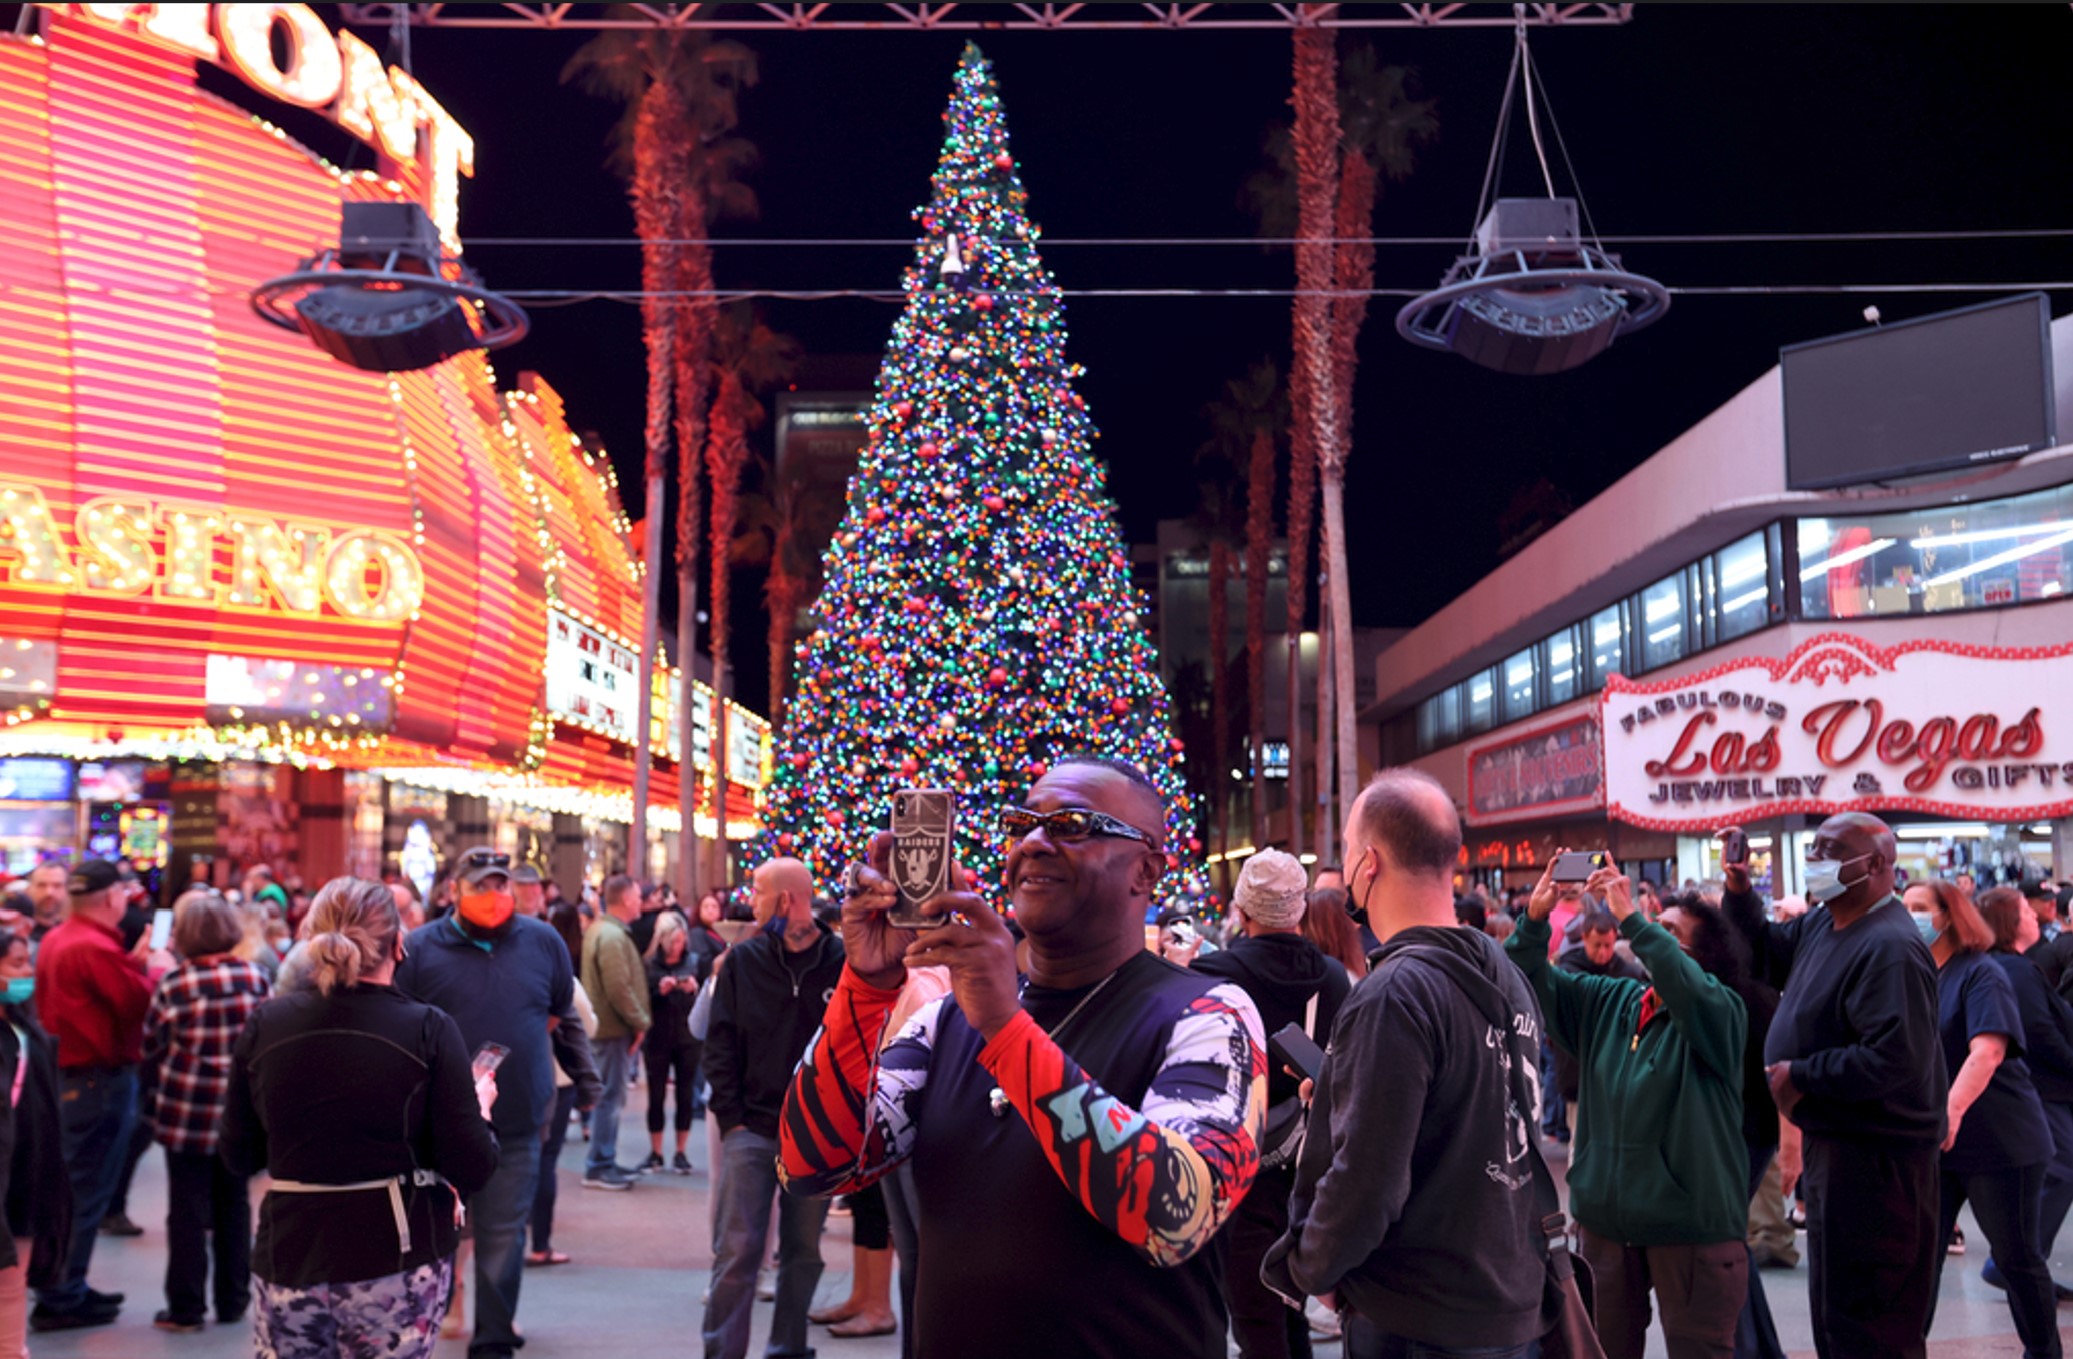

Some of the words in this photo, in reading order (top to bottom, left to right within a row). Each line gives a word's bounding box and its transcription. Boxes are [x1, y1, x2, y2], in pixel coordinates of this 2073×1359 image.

[1619, 691, 1788, 733] FABULOUS
[1643, 710, 1782, 778] Las
[1800, 698, 2045, 793] Vegas
[1648, 773, 1828, 804] JEWELRY
[1853, 772, 1881, 795] &
